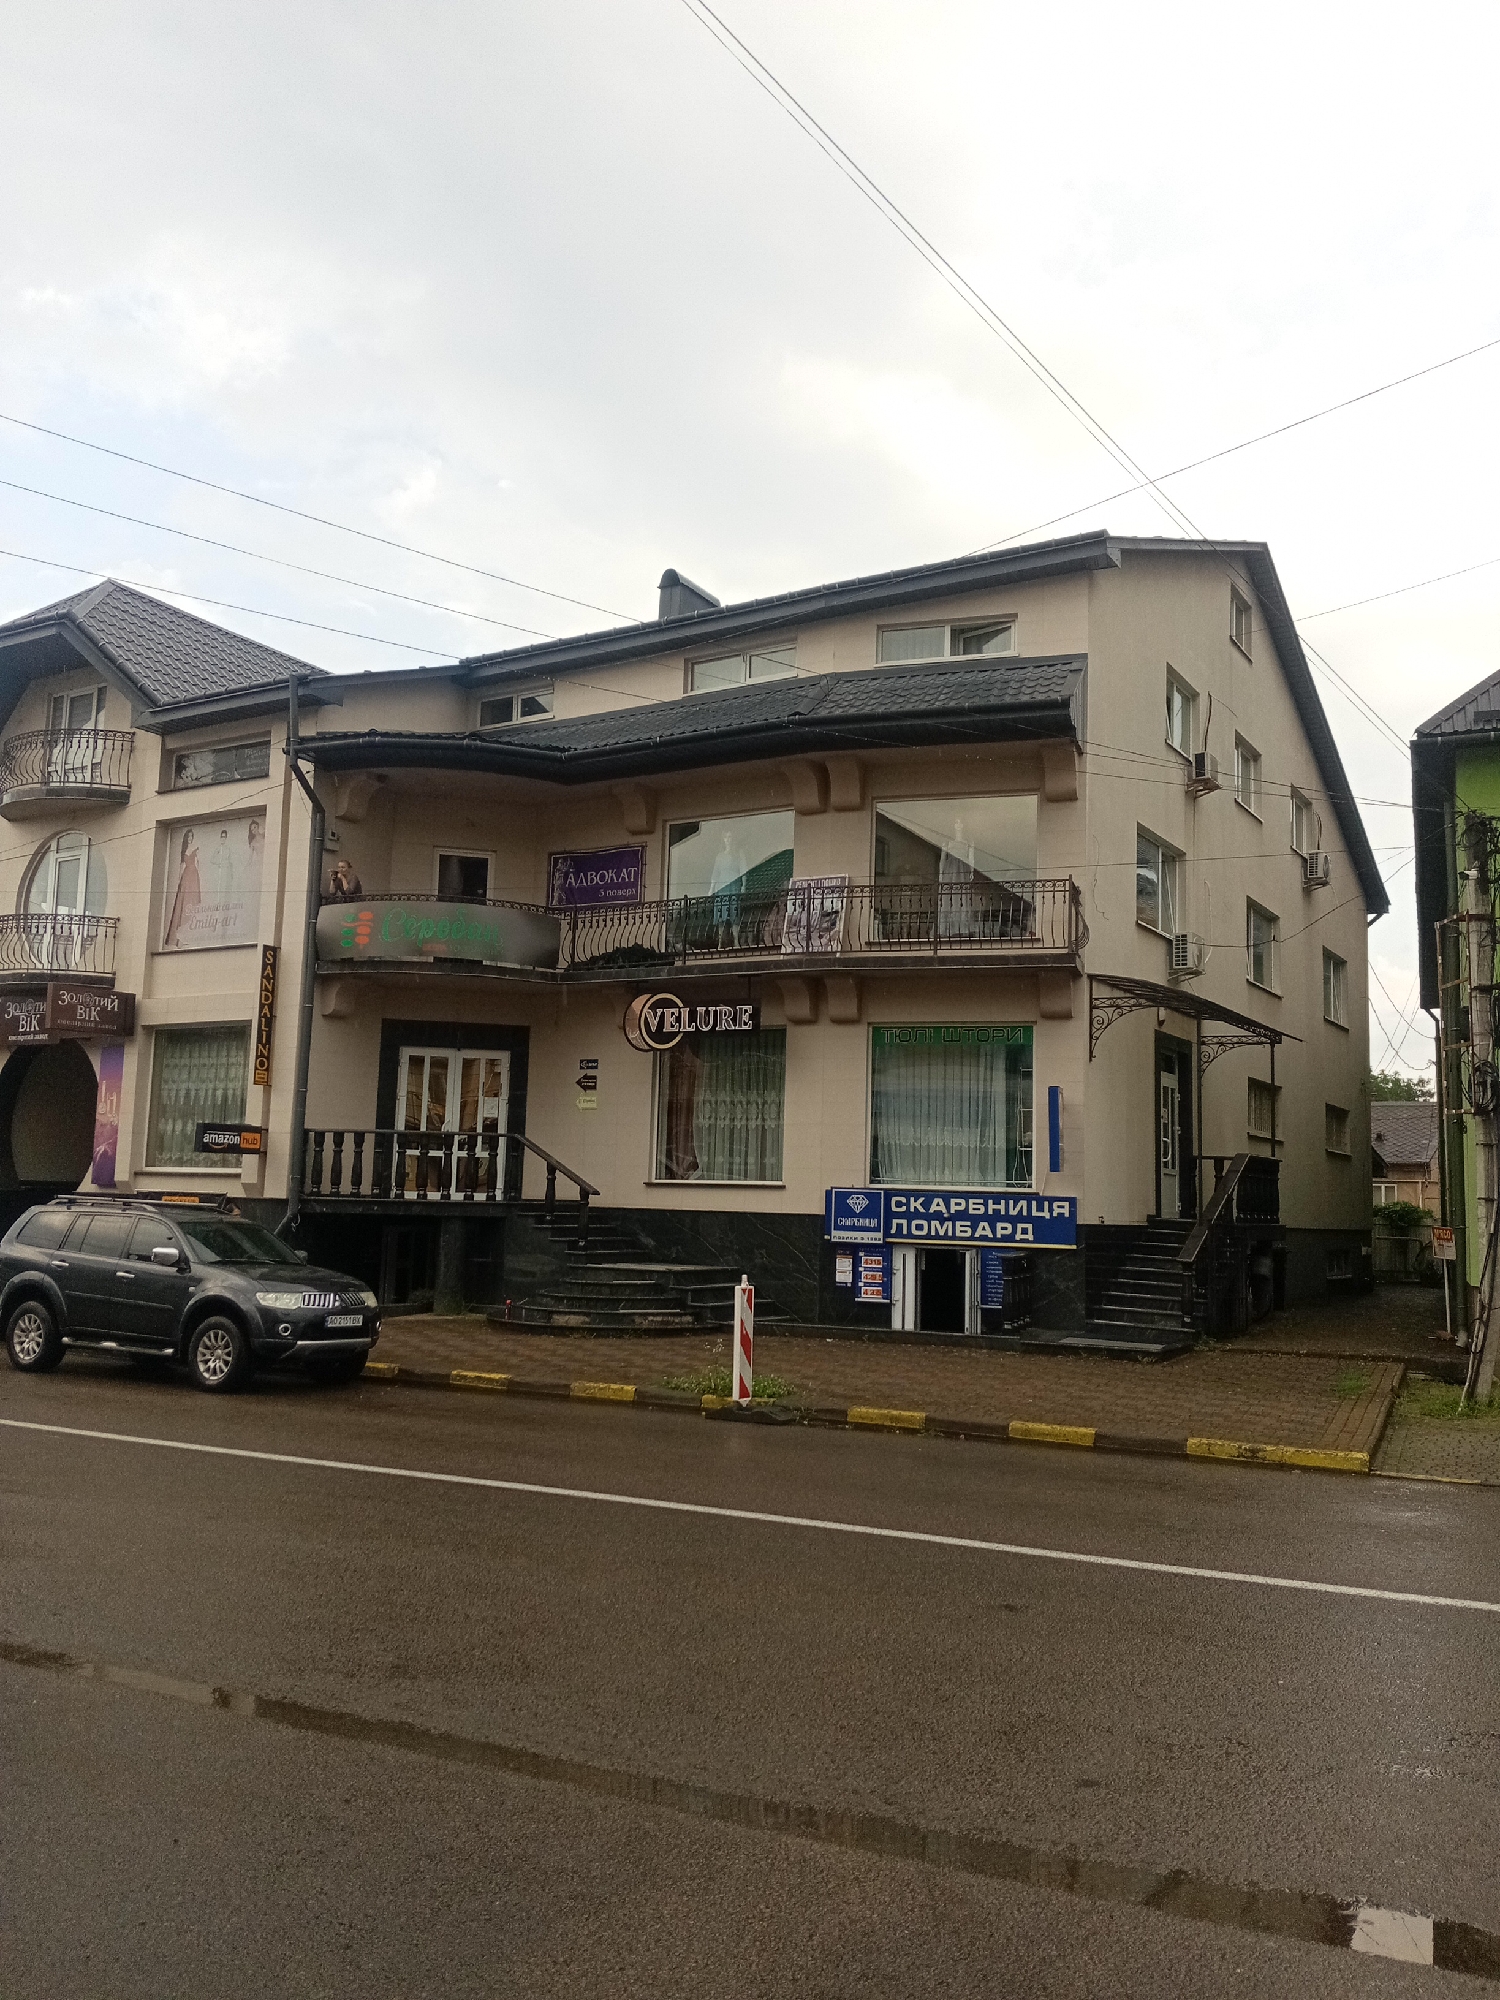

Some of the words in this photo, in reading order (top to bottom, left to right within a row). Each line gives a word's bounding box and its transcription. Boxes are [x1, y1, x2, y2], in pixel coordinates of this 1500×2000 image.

[565, 867, 638, 888] АДВОКАТ
[606, 887, 636, 897] поверх
[4, 998, 47, 1019] ЗОЛОТИ
[256, 950, 274, 1071] SANDALINO
[645, 1005, 753, 1033] VELURE
[881, 1027, 934, 1043] ТЮЛІ
[941, 1027, 1023, 1043] ШТОРИ
[203, 1132, 241, 1145] amazon
[242, 1135, 258, 1145] hub
[890, 1196, 1070, 1219] СКАРБНИЦЯ
[890, 1219, 1035, 1241] ЛОМБАРД
